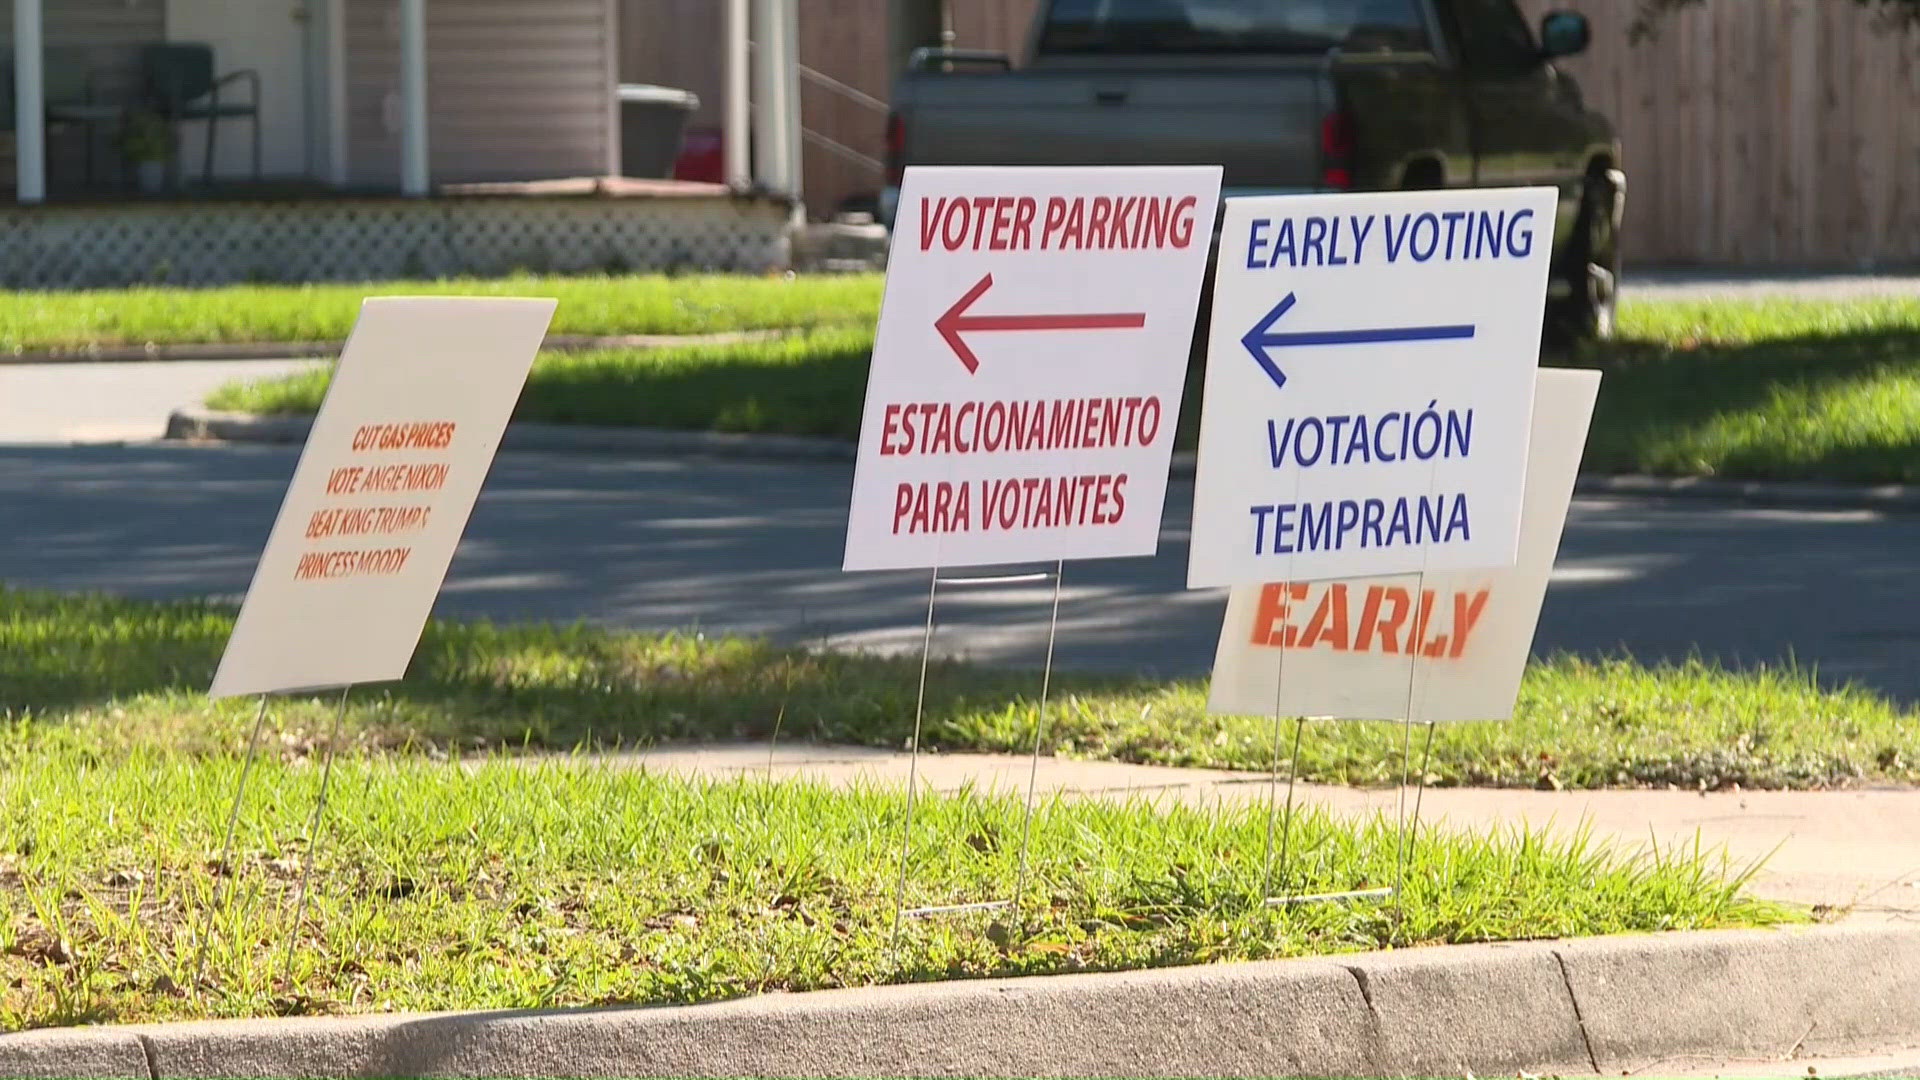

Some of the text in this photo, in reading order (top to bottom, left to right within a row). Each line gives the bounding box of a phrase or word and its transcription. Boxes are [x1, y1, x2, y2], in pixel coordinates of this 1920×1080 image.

[920, 196, 1196, 254] VOTER PARKING
[1247, 209, 1534, 270] EARLY VOTING
[352, 421, 456, 451] CUT GAS PRICES
[880, 396, 1162, 457] ESTACIONAMIENTO
[1268, 399, 1473, 469] VOTACIÓN
[327, 463, 450, 495] VOTE ANGIE NIXON
[893, 474, 1128, 535] PARA VOTANTES
[305, 508, 343, 539] BEAT
[338, 506, 375, 536] KING
[1251, 493, 1470, 555] TEMPRANA
[294, 546, 412, 580] PRINCESS MOODY
[1250, 582, 1491, 658] EARLY
